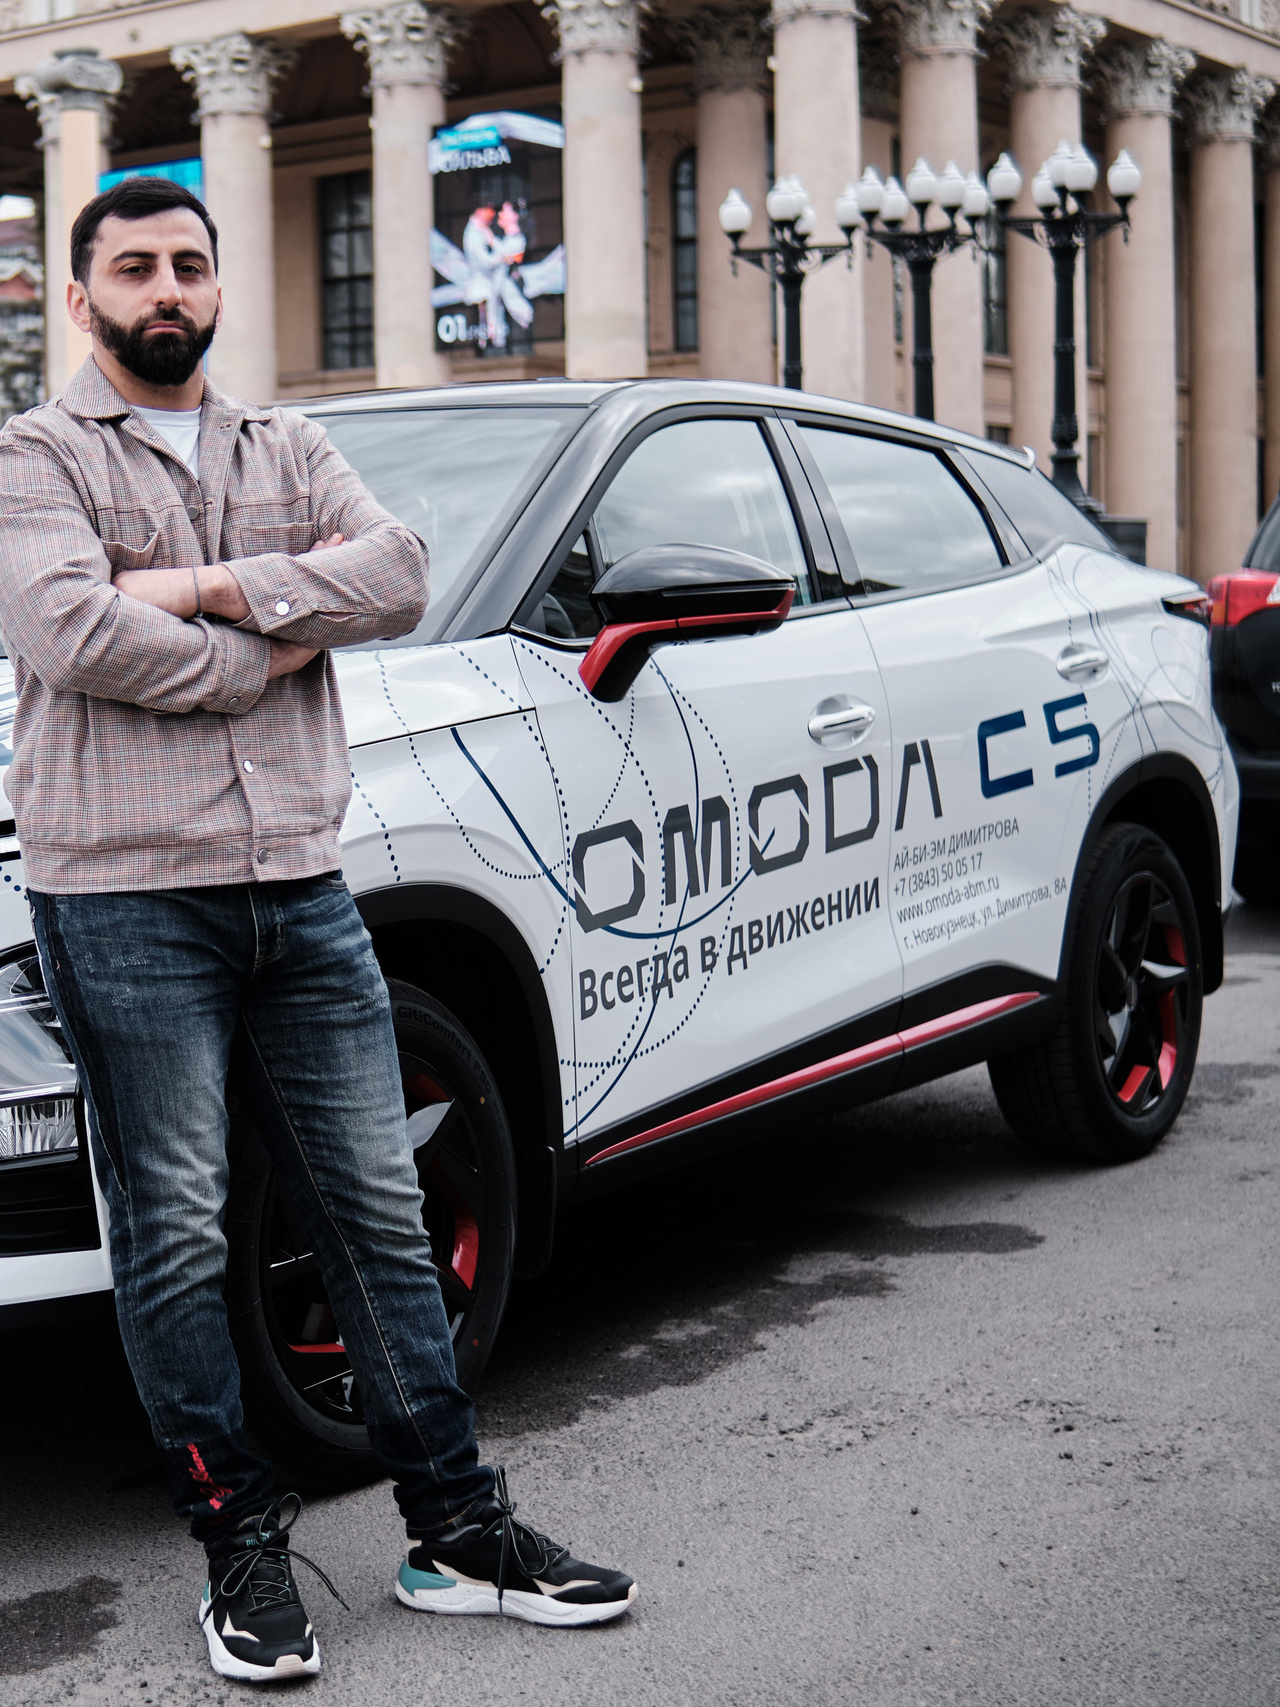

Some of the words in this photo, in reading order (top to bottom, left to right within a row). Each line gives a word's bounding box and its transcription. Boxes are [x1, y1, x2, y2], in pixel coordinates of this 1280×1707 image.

[437, 313, 468, 343] 01
[571, 738, 943, 934] OMODA
[977, 692, 1101, 799] C5
[893, 837, 946, 872] АЙ-БИ-ЭМ
[948, 816, 1020, 857] ДИМИТРОВА
[893, 878, 906, 897] +7
[908, 866, 940, 897] (3843)
[941, 862, 954, 883] 50
[955, 856, 968, 878] 05
[970, 852, 983, 871] 17
[896, 875, 1000, 924] www.omoda-abm.ru
[903, 936, 914, 950] г.
[912, 910, 981, 947] Новокузнецк,
[980, 905, 996, 927] ул.
[996, 885, 1052, 920] Димитрова,
[578, 944, 690, 1021] Всегда
[699, 935, 718, 974] в
[726, 876, 881, 976] движении
[397, 1006, 472, 1060] GitiComfort
